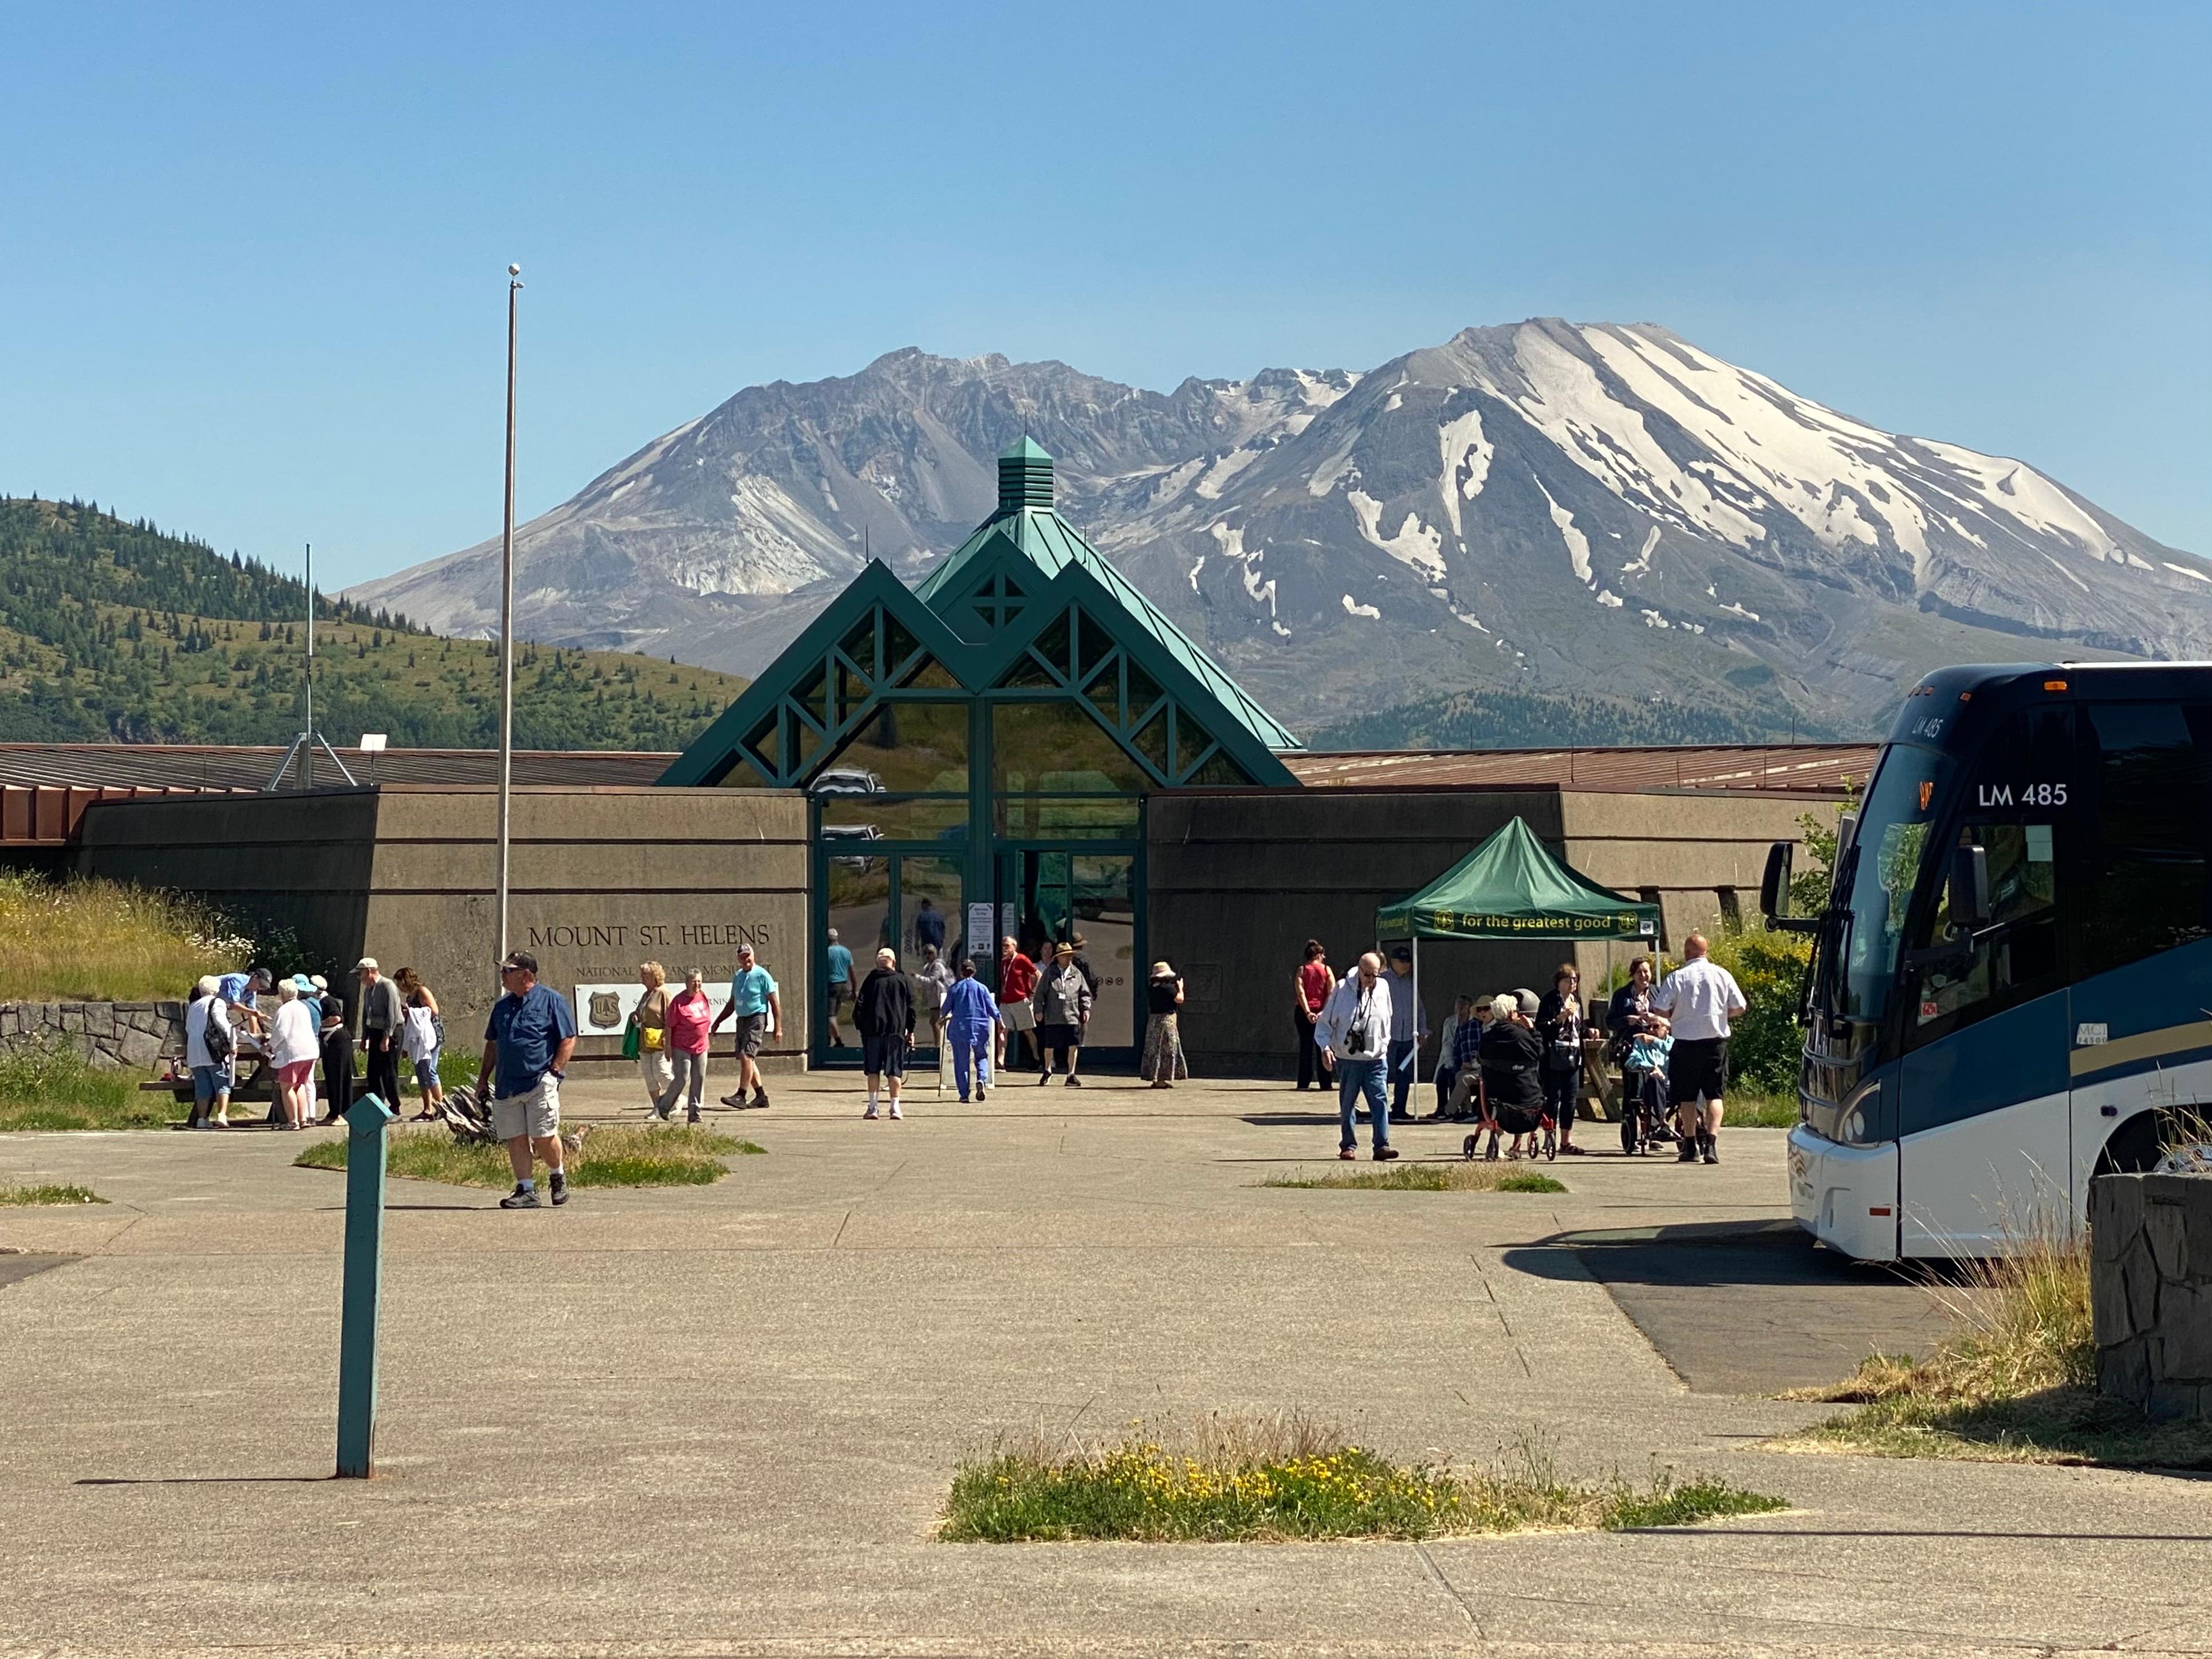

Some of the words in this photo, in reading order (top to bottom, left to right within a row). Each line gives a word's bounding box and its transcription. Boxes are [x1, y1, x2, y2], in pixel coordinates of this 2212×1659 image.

[1912, 716, 1928, 734] LM
[1924, 718, 1943, 738] 485
[1979, 784, 2013, 806] LM
[2021, 783, 2067, 805] 485
[1462, 914, 1482, 927] for
[1486, 915, 1509, 927] the
[1513, 917, 1571, 930] greatest
[1574, 915, 1611, 931] good
[528, 926, 628, 947] MOUNT
[640, 925, 670, 946] ST.
[680, 924, 770, 945] HELENS
[576, 966, 635, 977] NATIONAL
